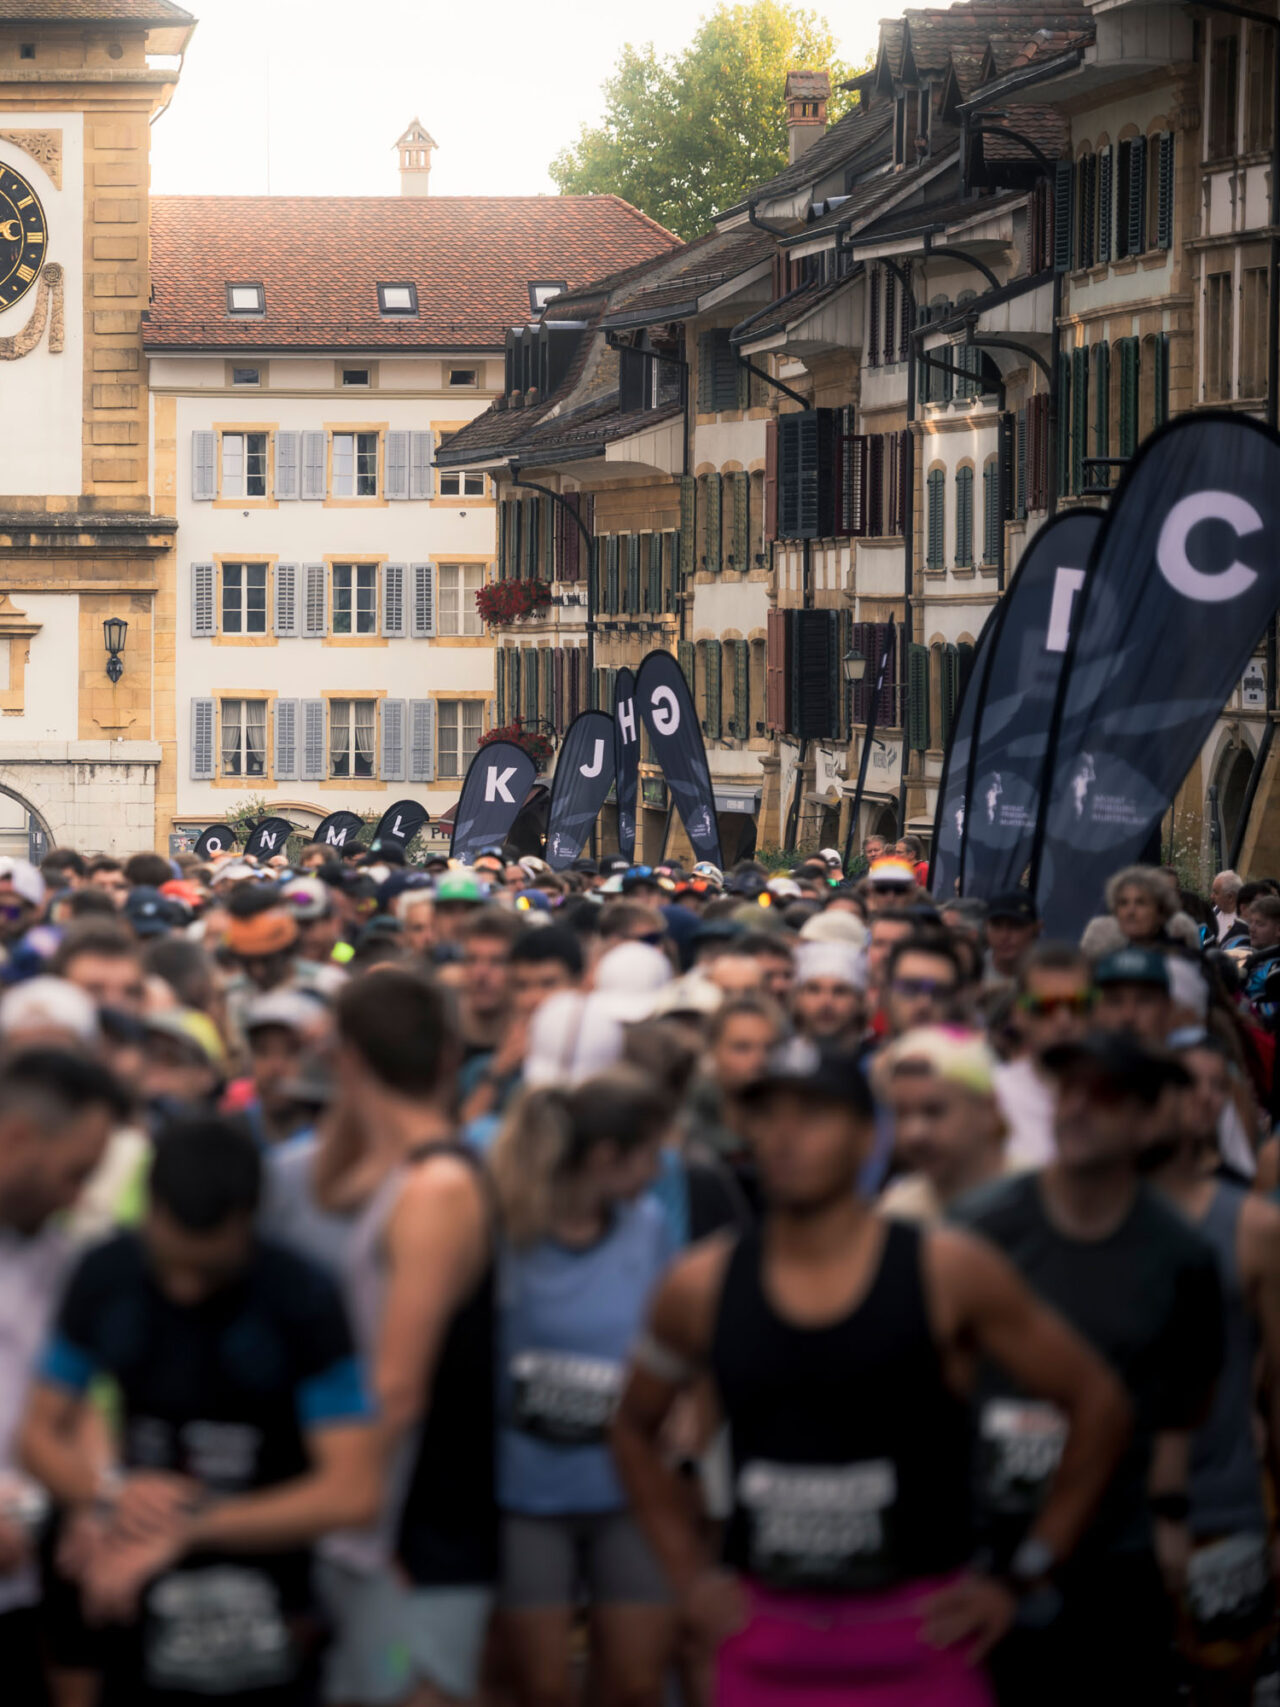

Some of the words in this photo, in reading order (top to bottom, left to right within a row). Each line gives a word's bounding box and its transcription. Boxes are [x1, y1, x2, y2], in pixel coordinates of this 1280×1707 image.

[17, 194, 35, 210] II
[26, 231, 43, 244] III
[1156, 490, 1264, 603] C
[618, 697, 637, 745] H
[579, 739, 605, 778] J
[484, 765, 518, 803] K
[325, 825, 348, 847] M
[392, 814, 406, 838] L
[206, 837, 222, 853] O
[260, 830, 277, 849] N
